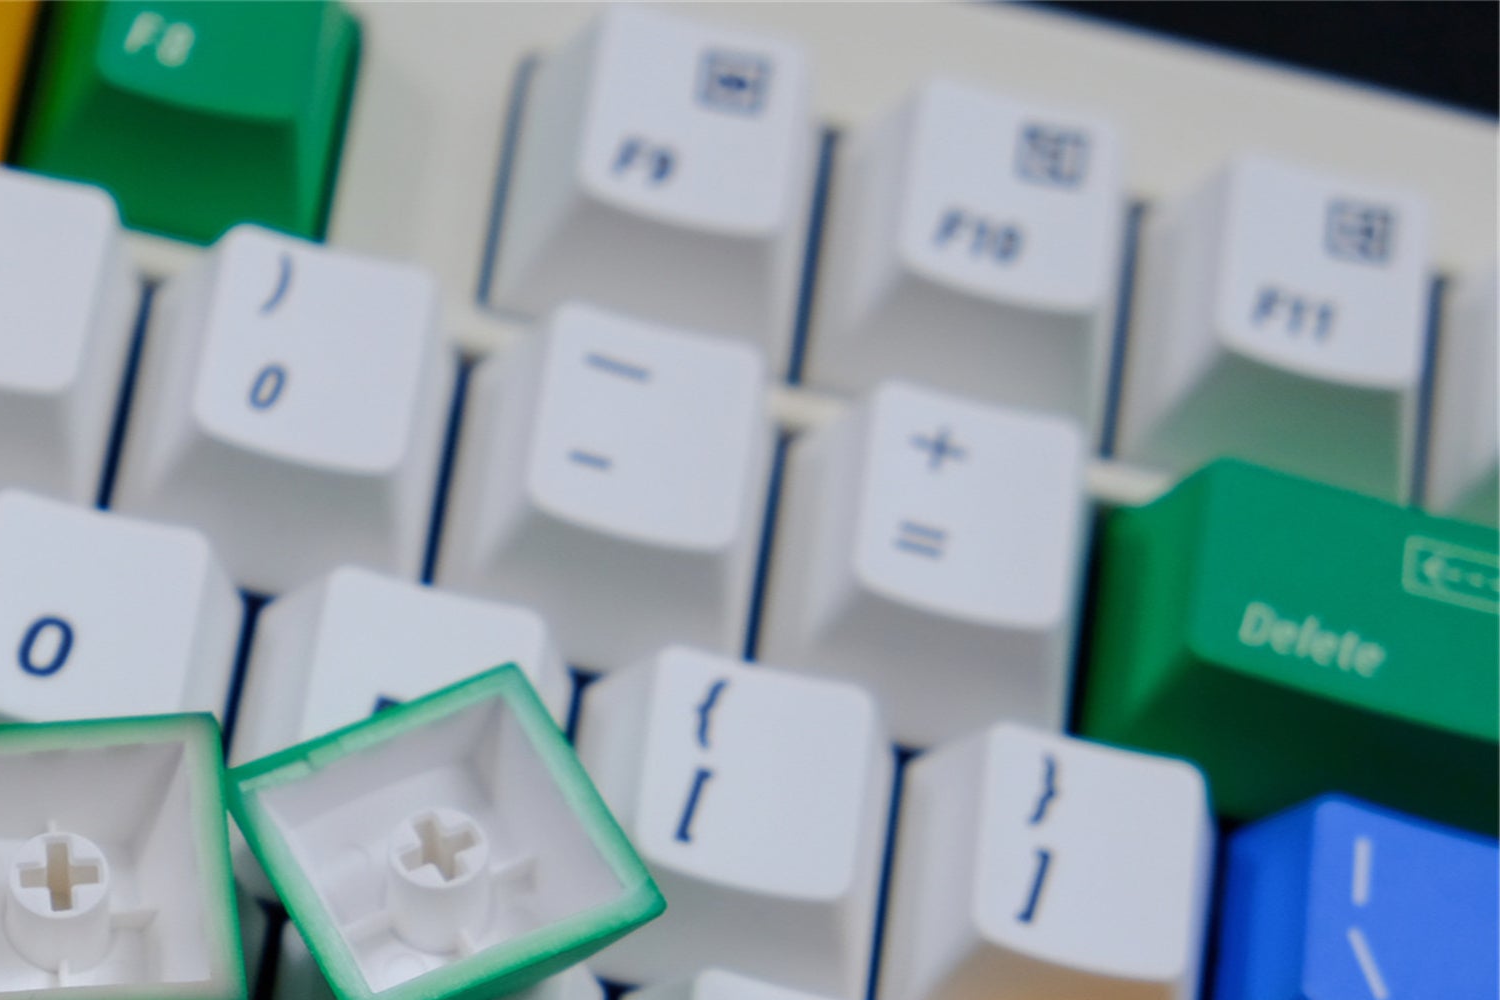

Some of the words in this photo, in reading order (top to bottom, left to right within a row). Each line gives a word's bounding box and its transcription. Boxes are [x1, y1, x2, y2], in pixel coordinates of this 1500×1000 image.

[123, 11, 195, 67] F8
[260, 254, 295, 314] )
[248, 364, 288, 411] 0
[915, 431, 964, 467] +
[894, 520, 949, 561] =
[17, 616, 75, 678] O
[1238, 602, 1387, 678] Delete
[674, 767, 713, 844] [
[1016, 848, 1053, 925] ]
